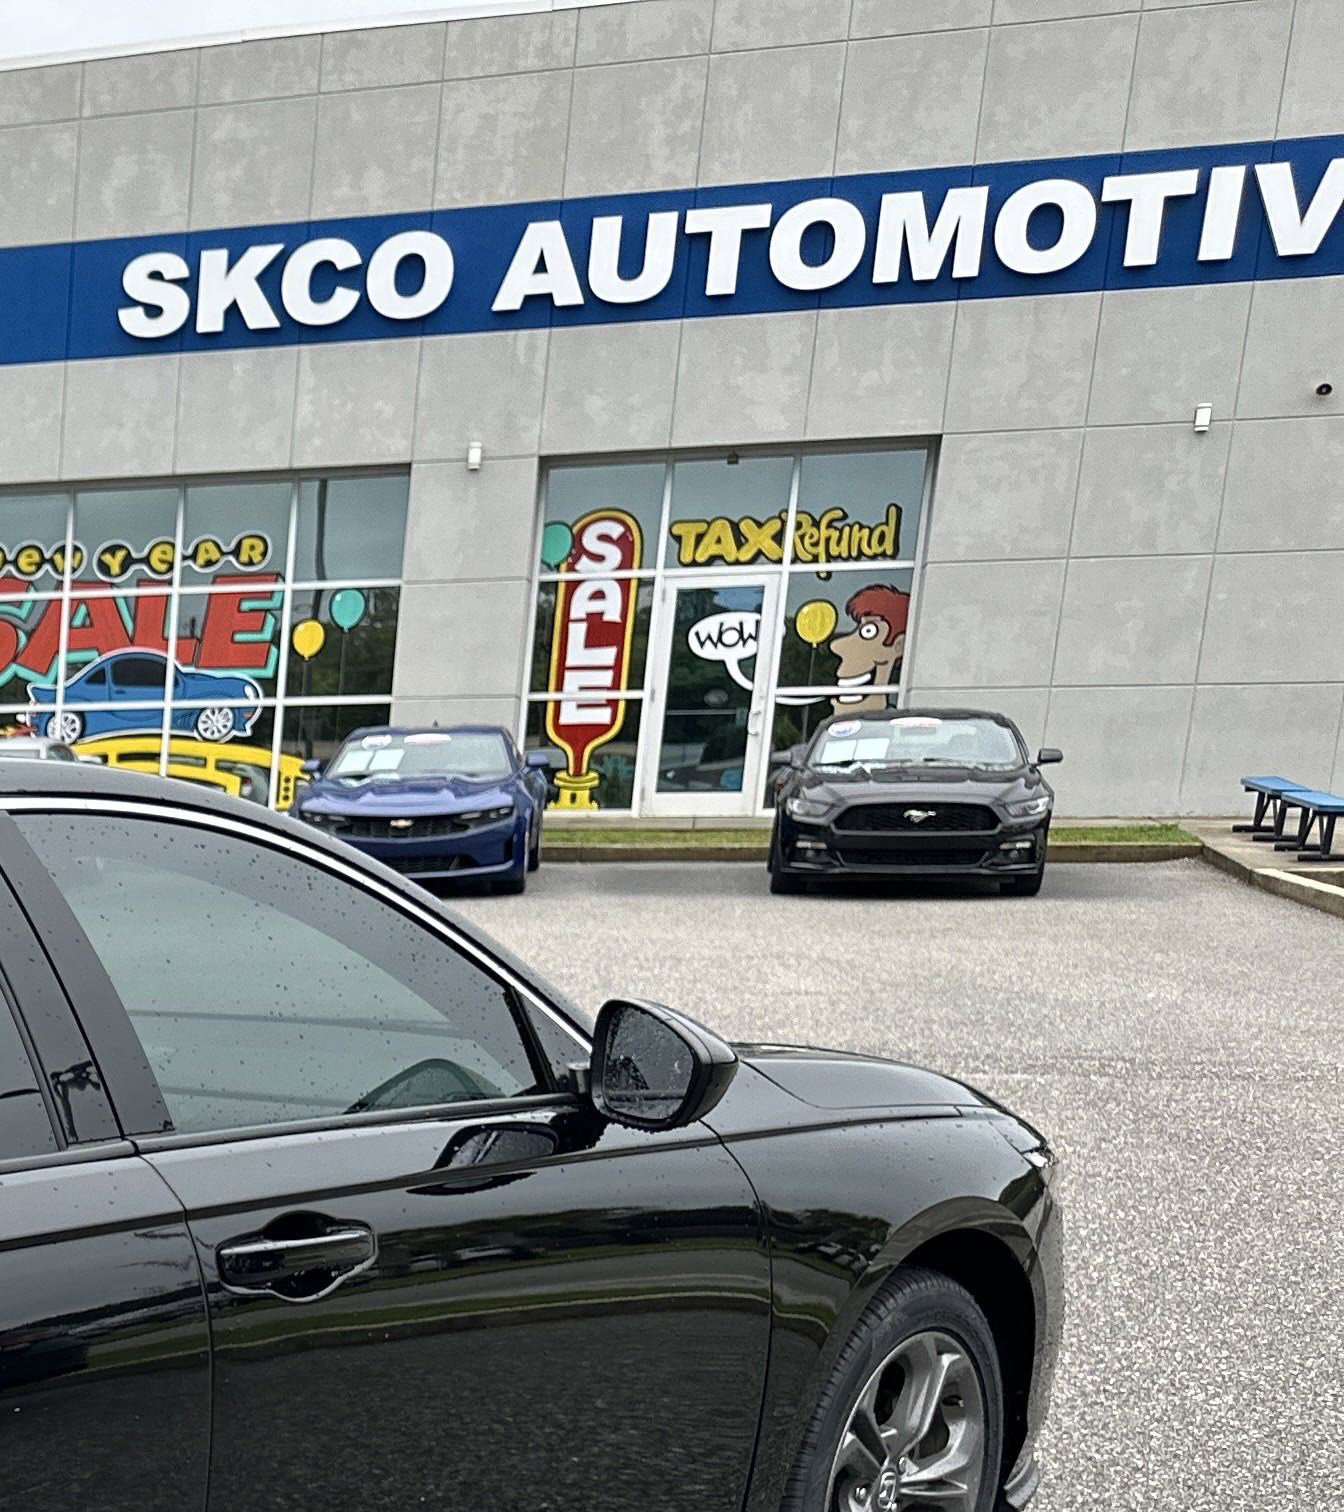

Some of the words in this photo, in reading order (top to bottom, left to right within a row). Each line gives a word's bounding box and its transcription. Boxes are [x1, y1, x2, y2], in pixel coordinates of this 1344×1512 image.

[117, 228, 455, 341] SKCO
[491, 158, 1344, 314] AUTOMOTIV
[559, 519, 626, 725] SALE
[670, 516, 784, 566] TAX
[782, 503, 902, 580] Refund
